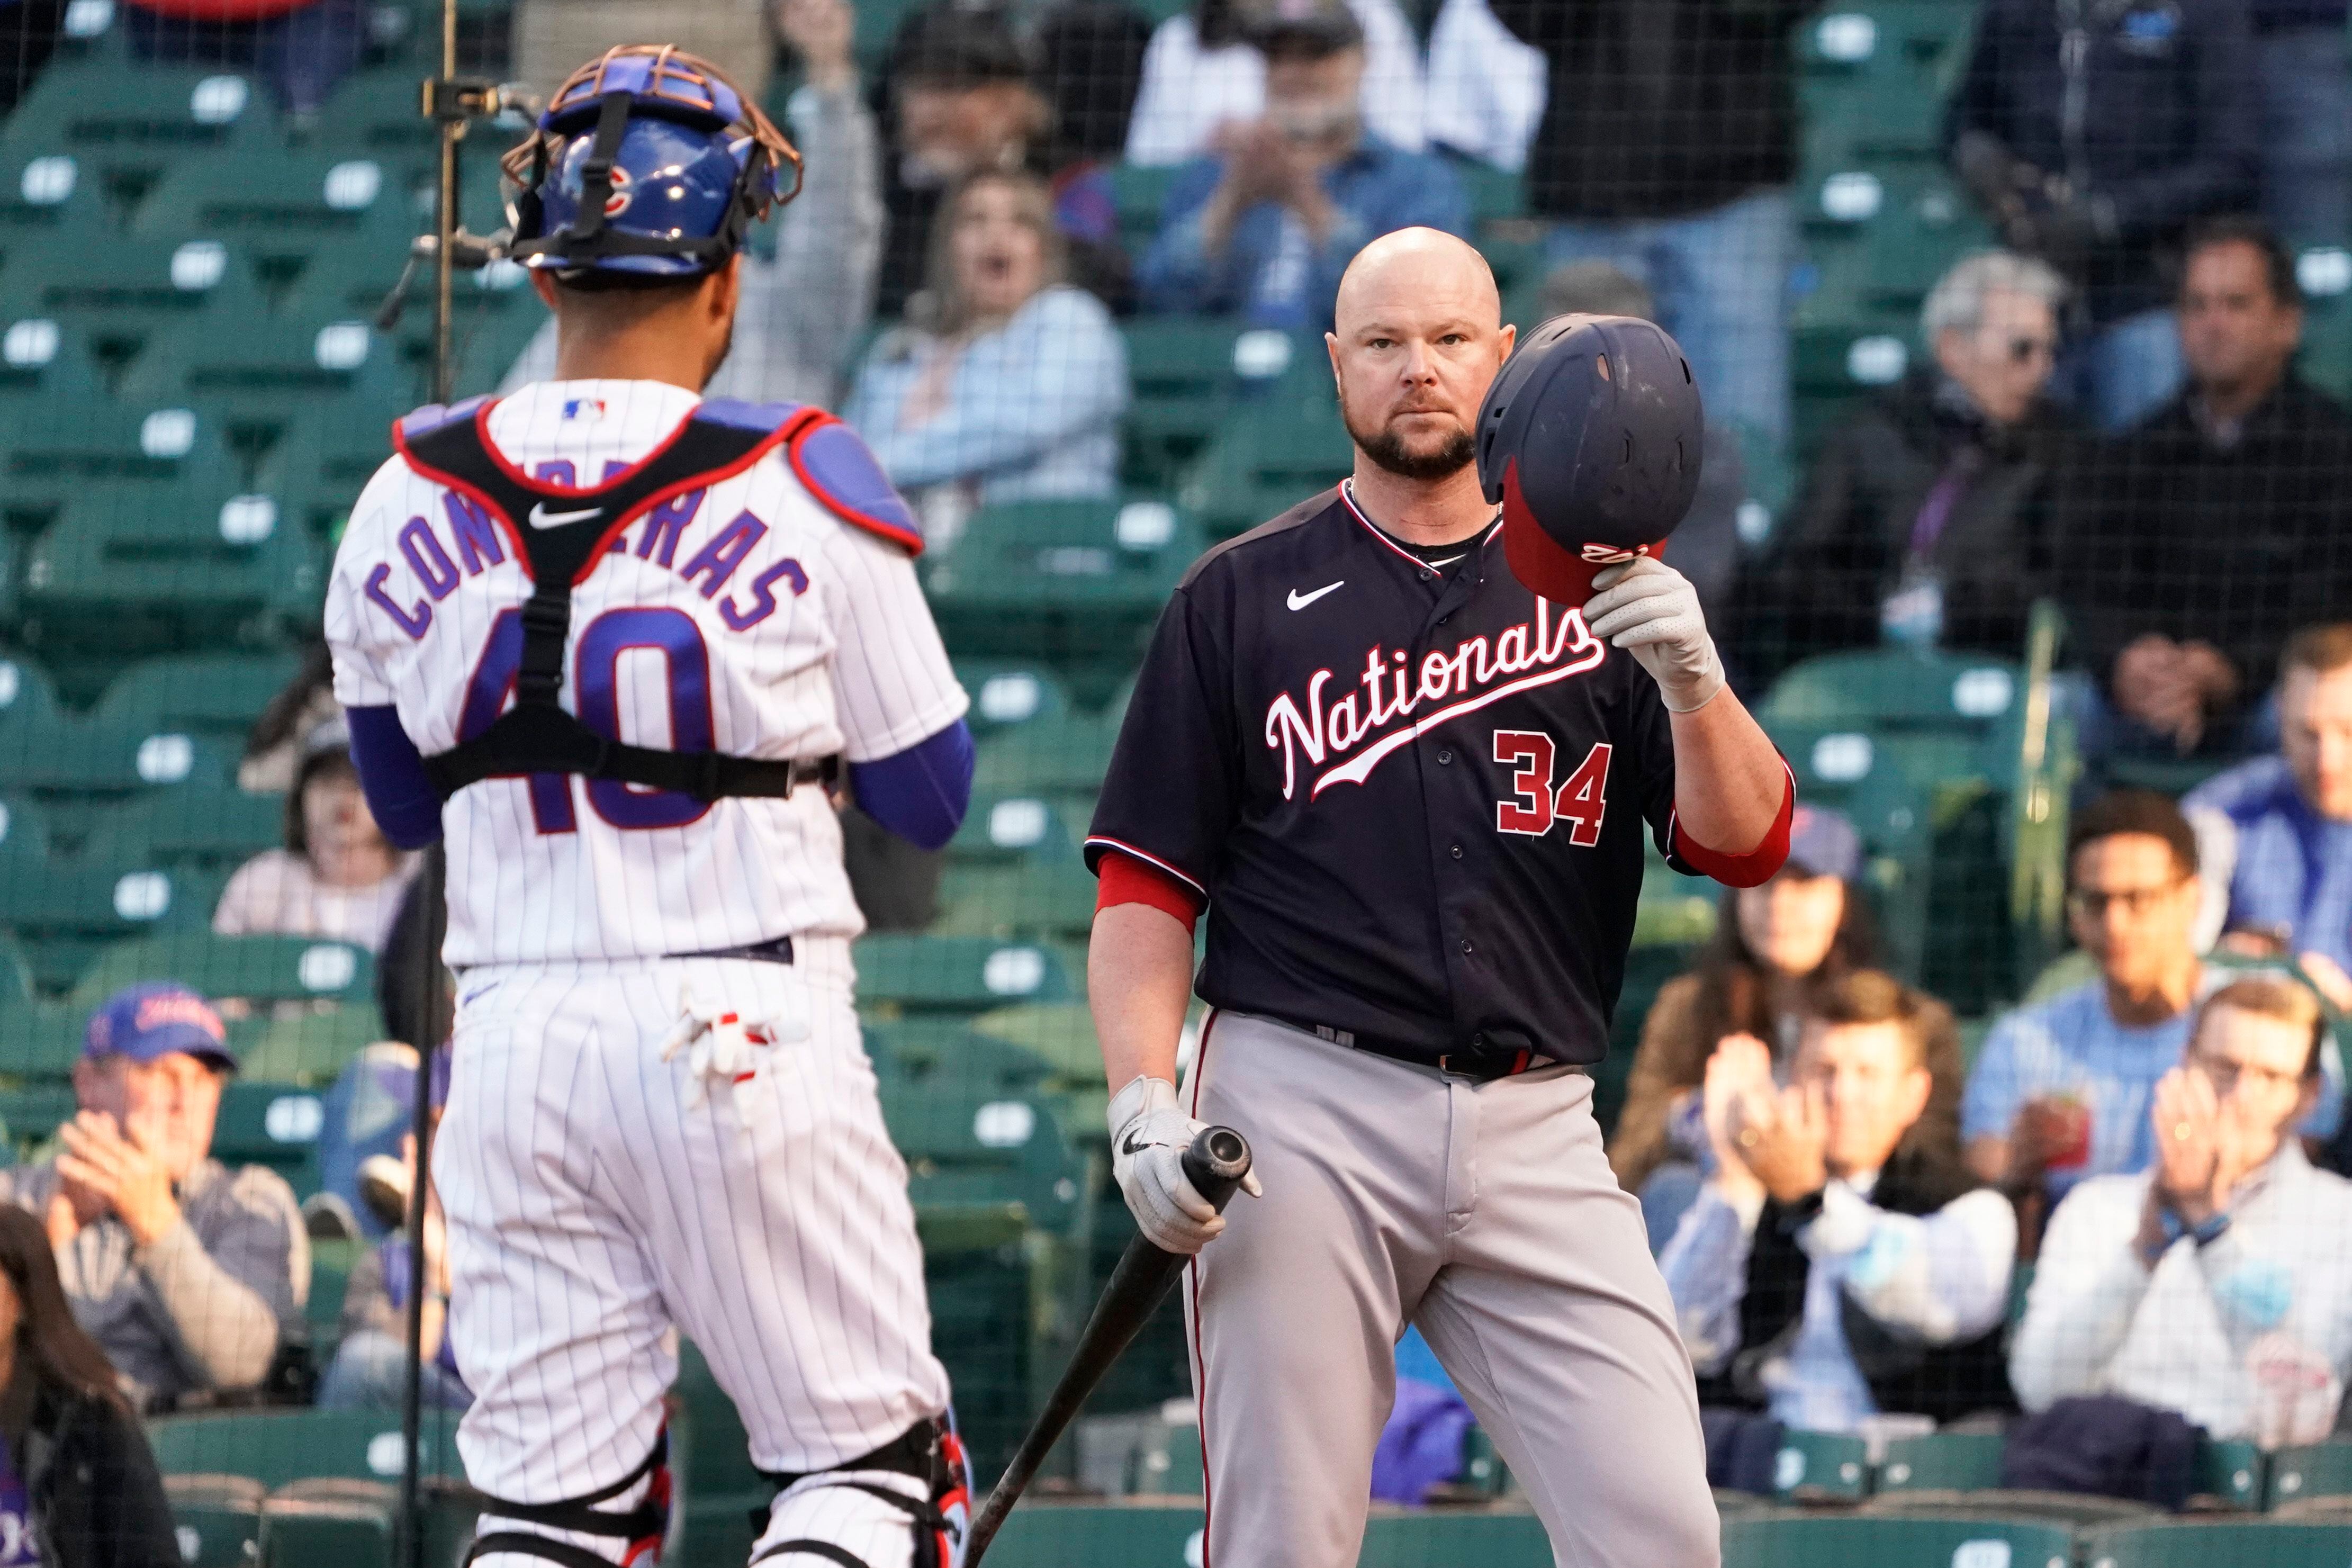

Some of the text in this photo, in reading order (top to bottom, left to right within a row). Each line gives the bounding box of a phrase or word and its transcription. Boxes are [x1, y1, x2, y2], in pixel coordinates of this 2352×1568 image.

[364, 458, 810, 641] CONRAS
[1265, 593, 1605, 801] Nationals
[1493, 728, 1612, 847] 34
